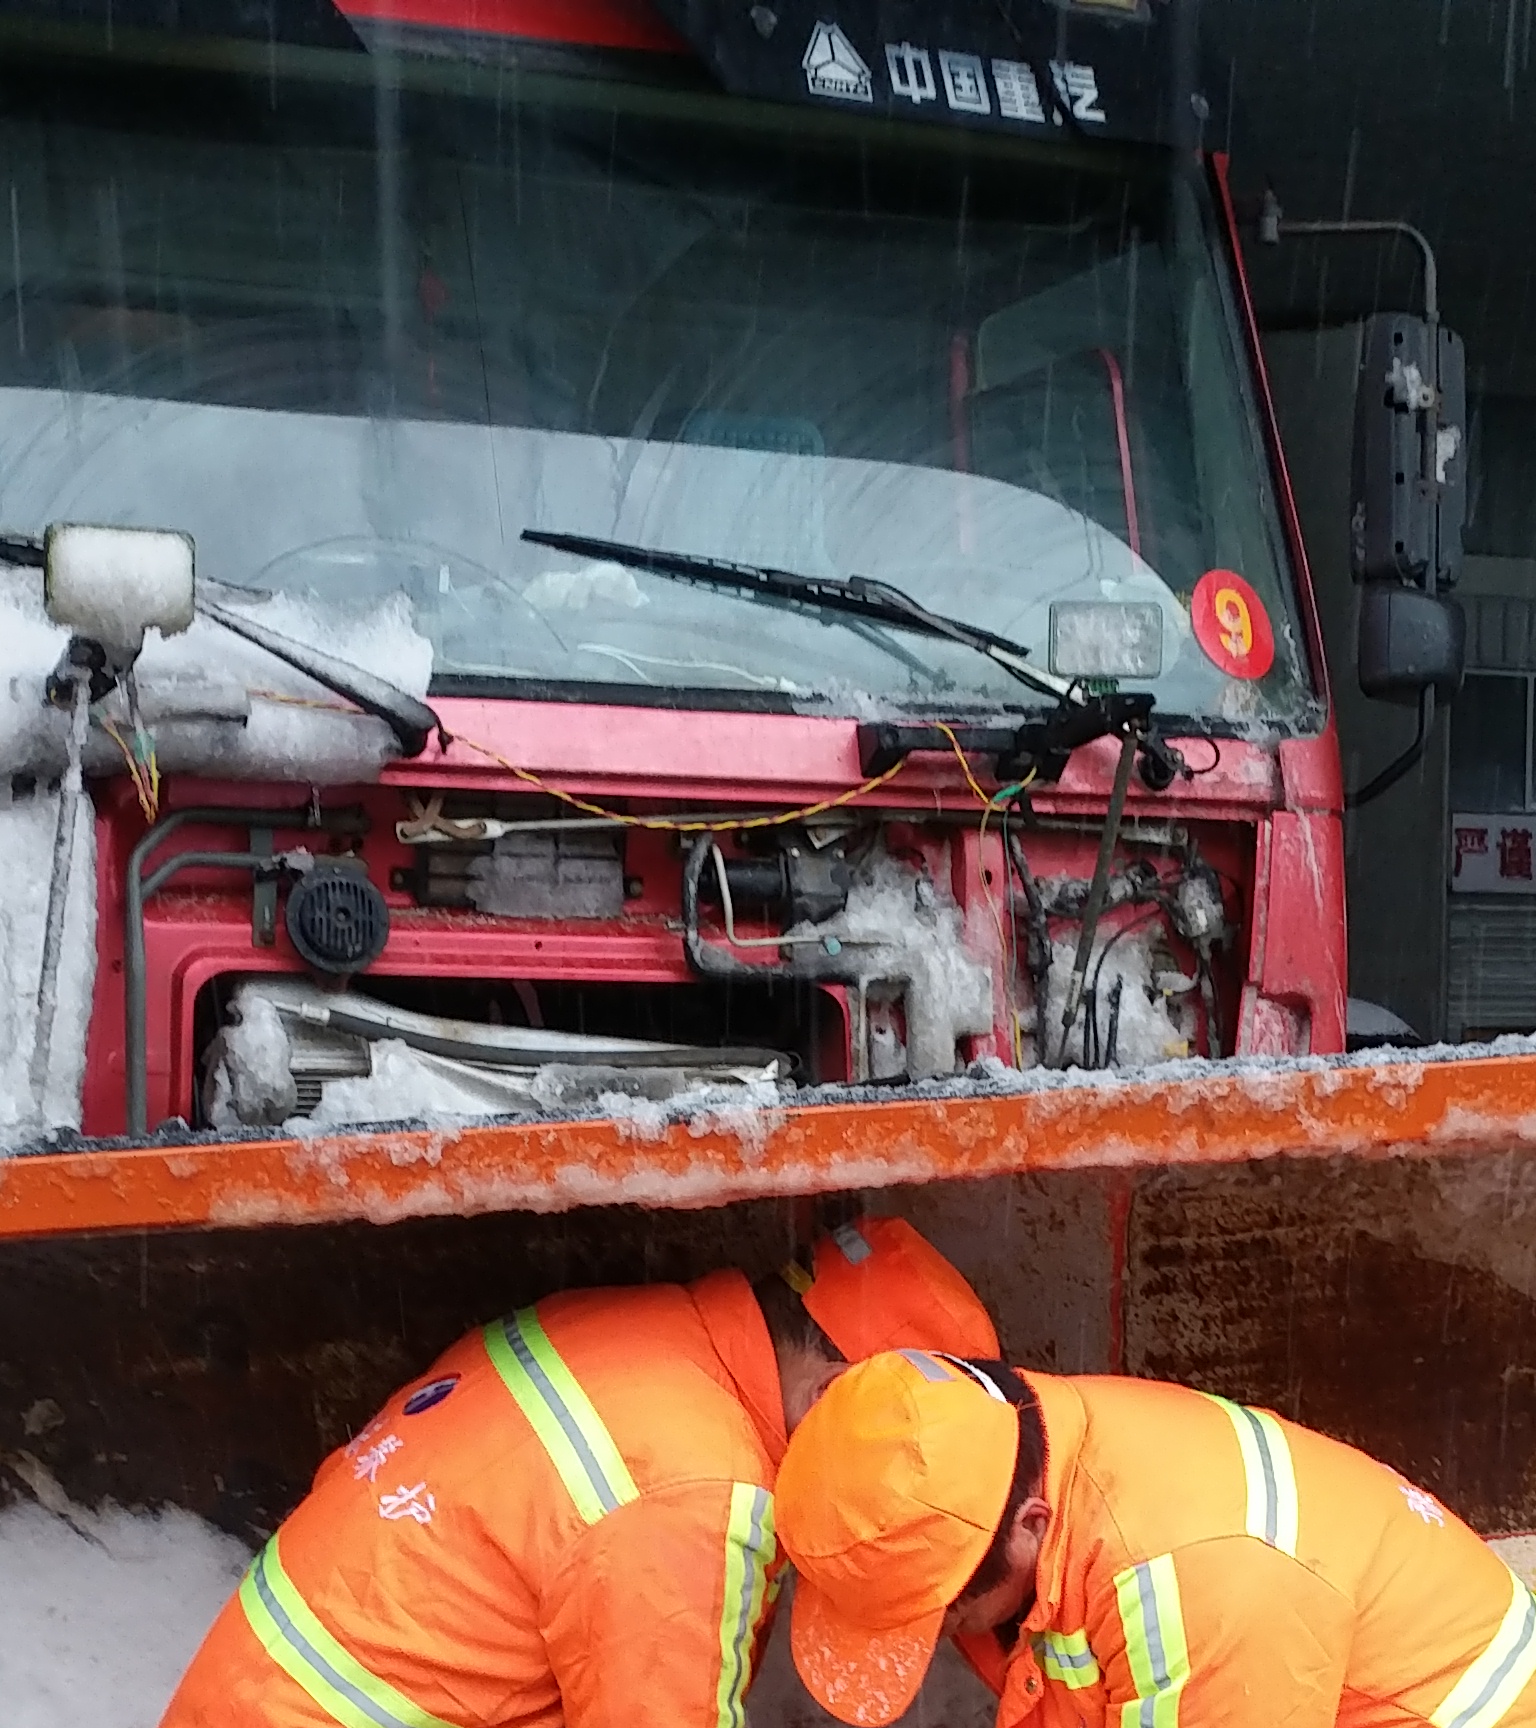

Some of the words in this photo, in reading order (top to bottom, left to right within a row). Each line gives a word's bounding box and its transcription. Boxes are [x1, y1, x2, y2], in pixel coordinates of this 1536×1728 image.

[885, 41, 1106, 126] 中国重汽
[1215, 588, 1253, 659] 9
